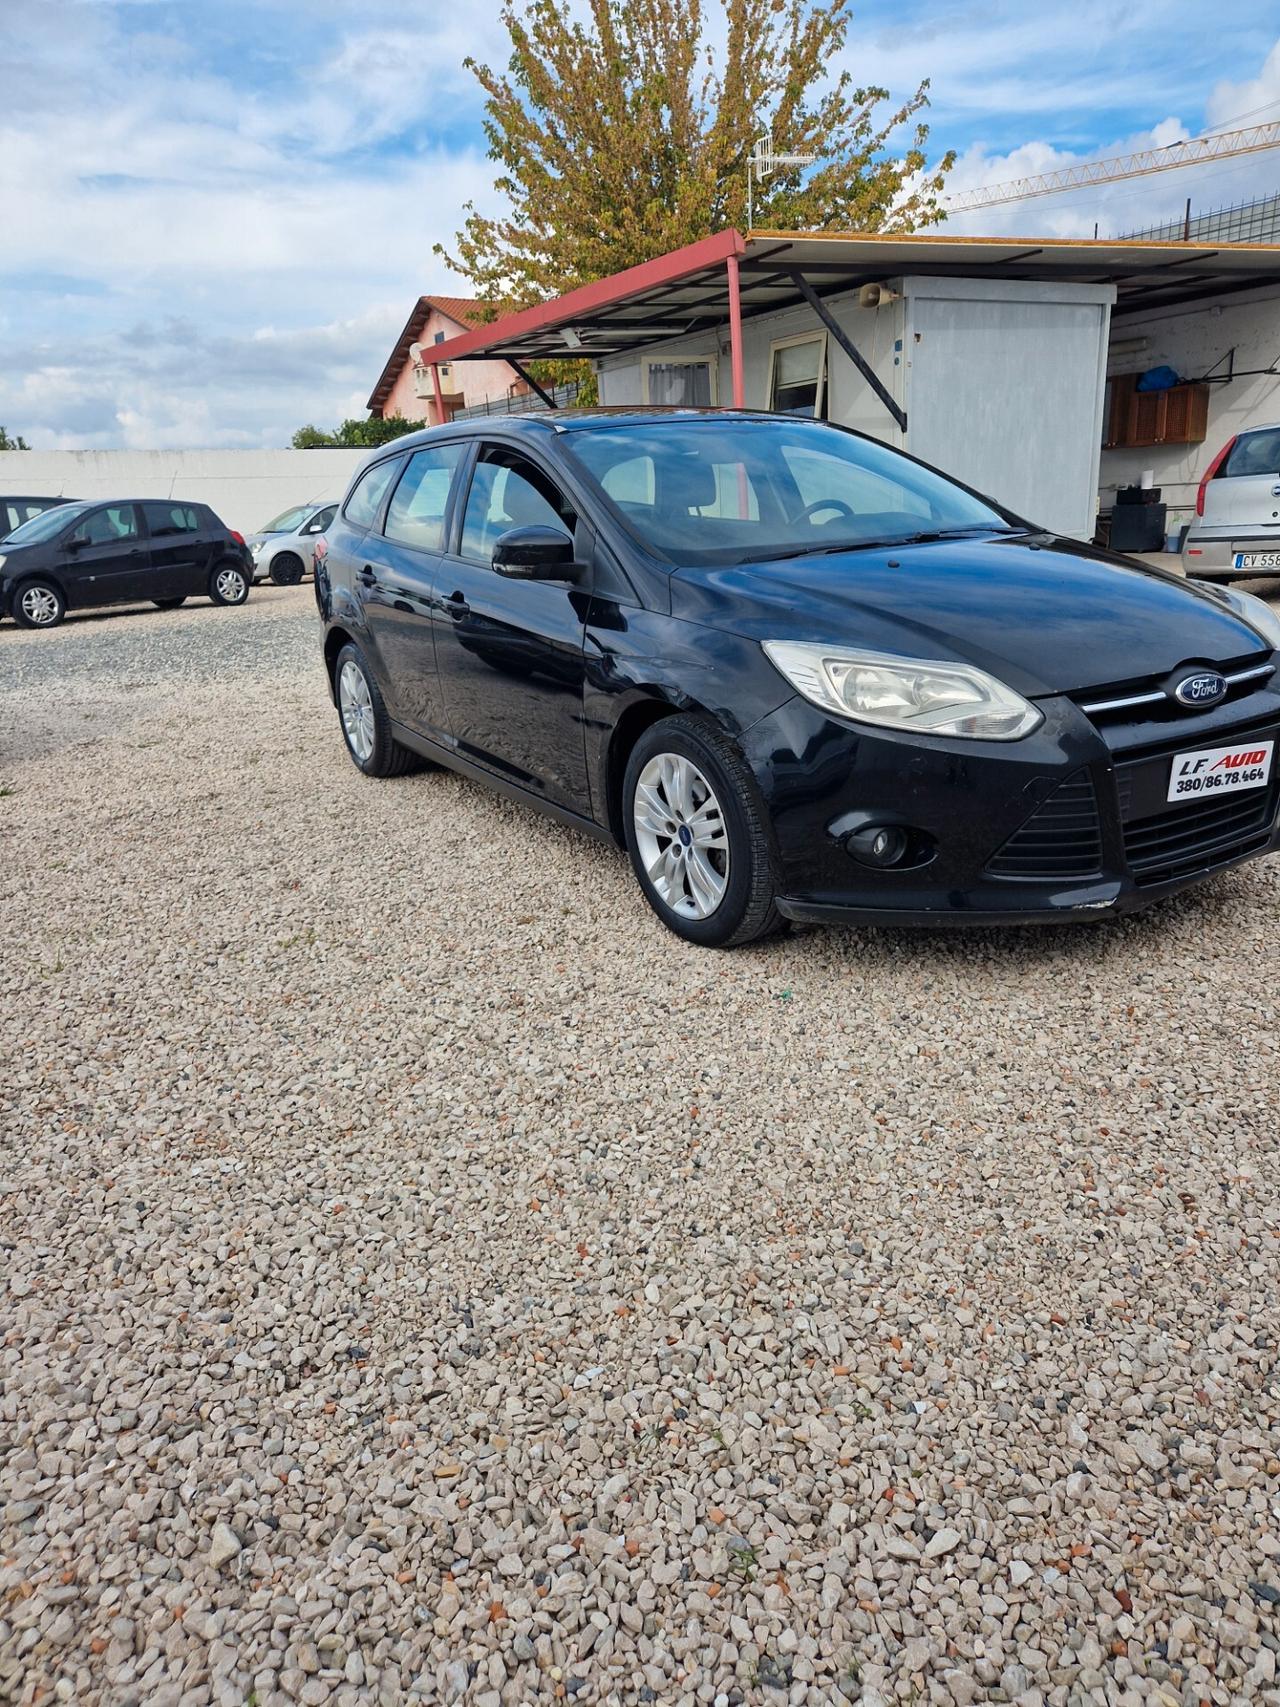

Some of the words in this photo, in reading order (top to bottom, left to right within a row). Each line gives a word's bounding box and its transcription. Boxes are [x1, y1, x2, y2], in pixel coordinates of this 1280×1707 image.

[1243, 555, 1257, 567] CV
[1192, 678, 1218, 698] Ford
[1179, 758, 1209, 776] L.F.
[1209, 750, 1267, 771] AUTO
[1176, 768, 1265, 793] 380/86.78.464
